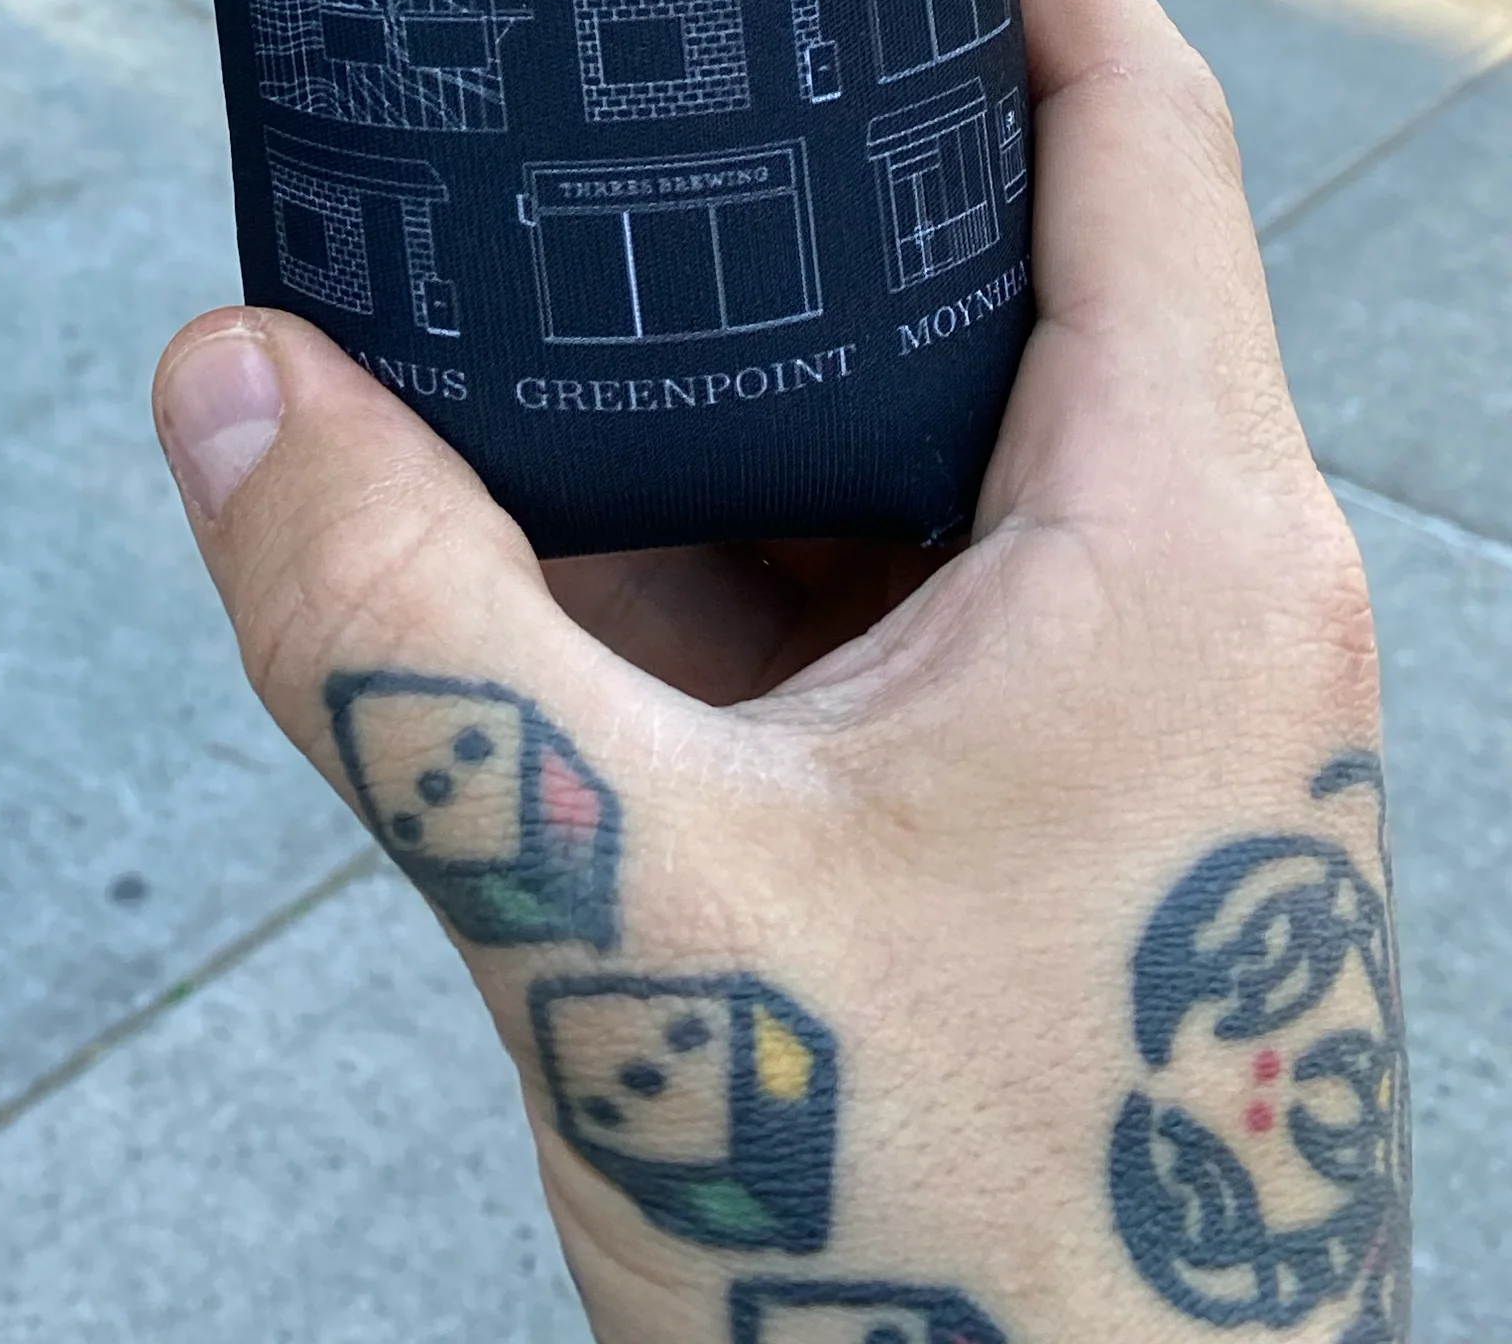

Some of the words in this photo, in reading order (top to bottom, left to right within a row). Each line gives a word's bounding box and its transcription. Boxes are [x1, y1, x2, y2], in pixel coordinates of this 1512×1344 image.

[358, 351, 469, 401] ANUS
[516, 342, 857, 412] GREENPOINT
[896, 255, 1029, 356] MOYNIHA
